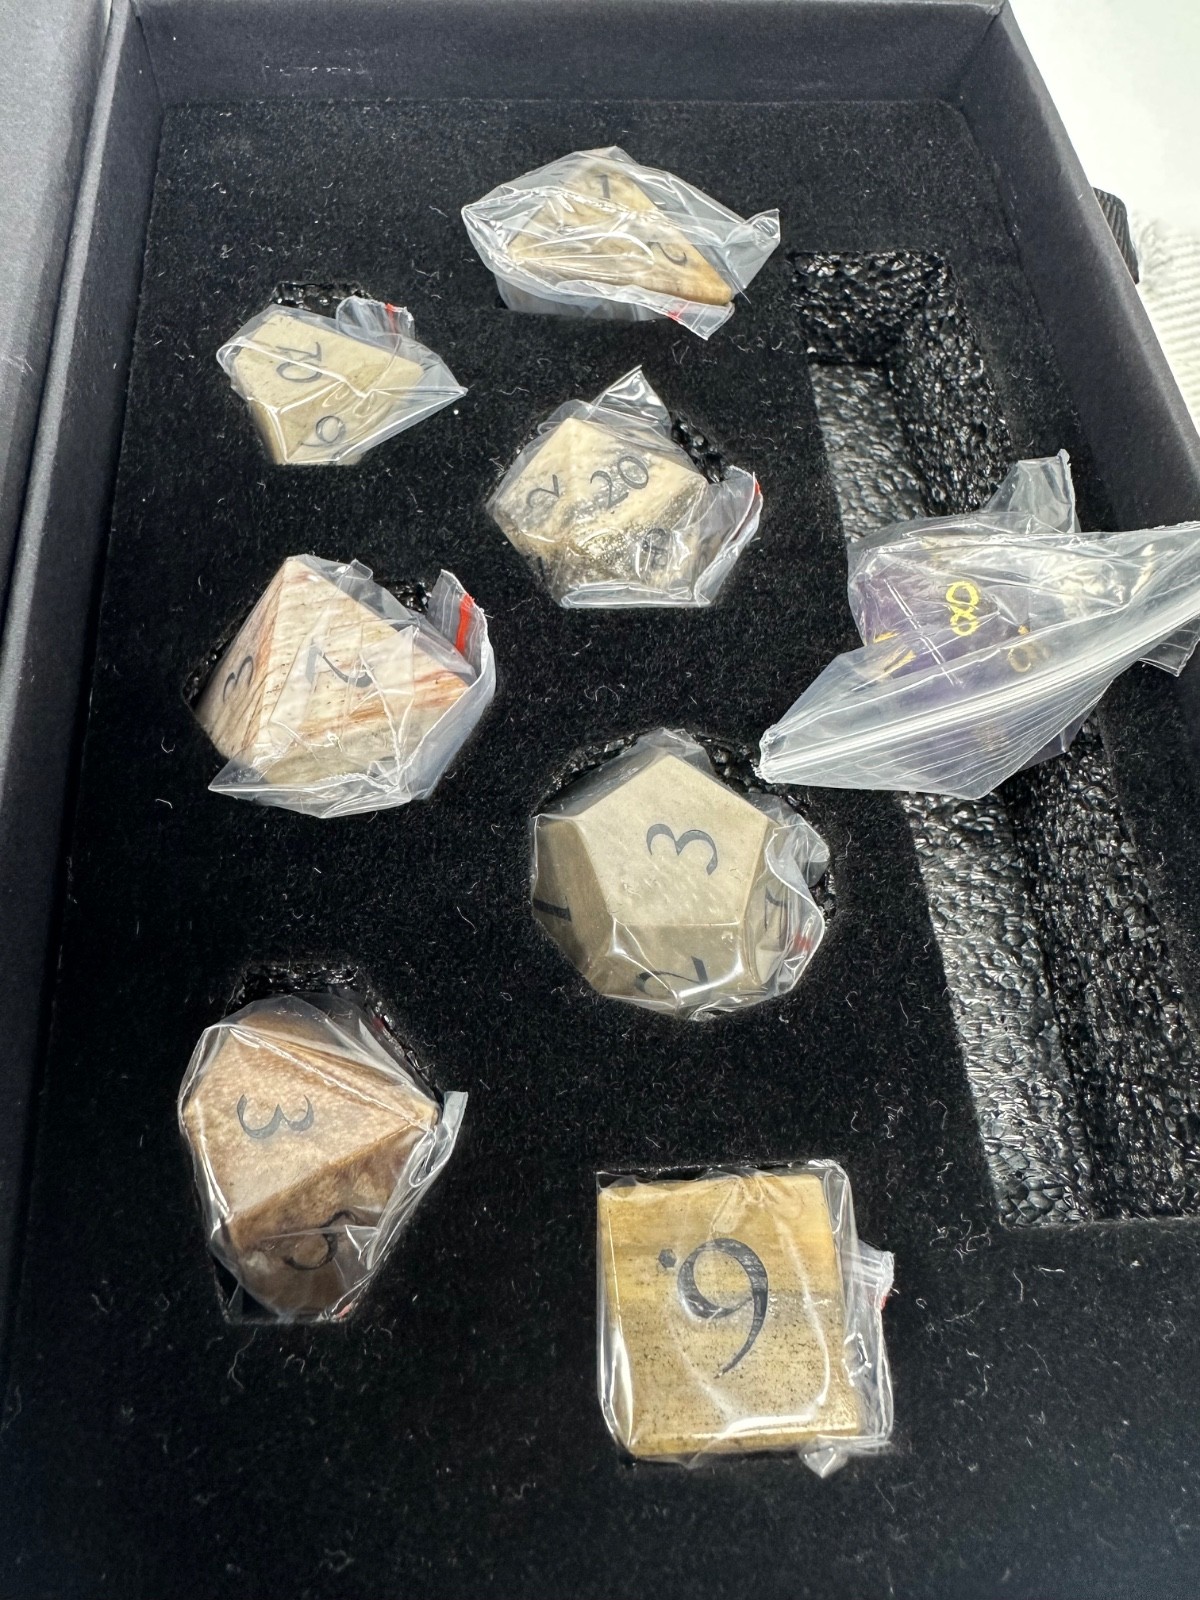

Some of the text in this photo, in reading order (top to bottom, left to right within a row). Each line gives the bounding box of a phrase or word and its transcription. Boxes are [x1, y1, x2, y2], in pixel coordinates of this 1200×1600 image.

[590, 455, 650, 509] 20
[945, 580, 980, 637] 8
[646, 823, 718, 876] 3
[236, 1094, 315, 1139] 3
